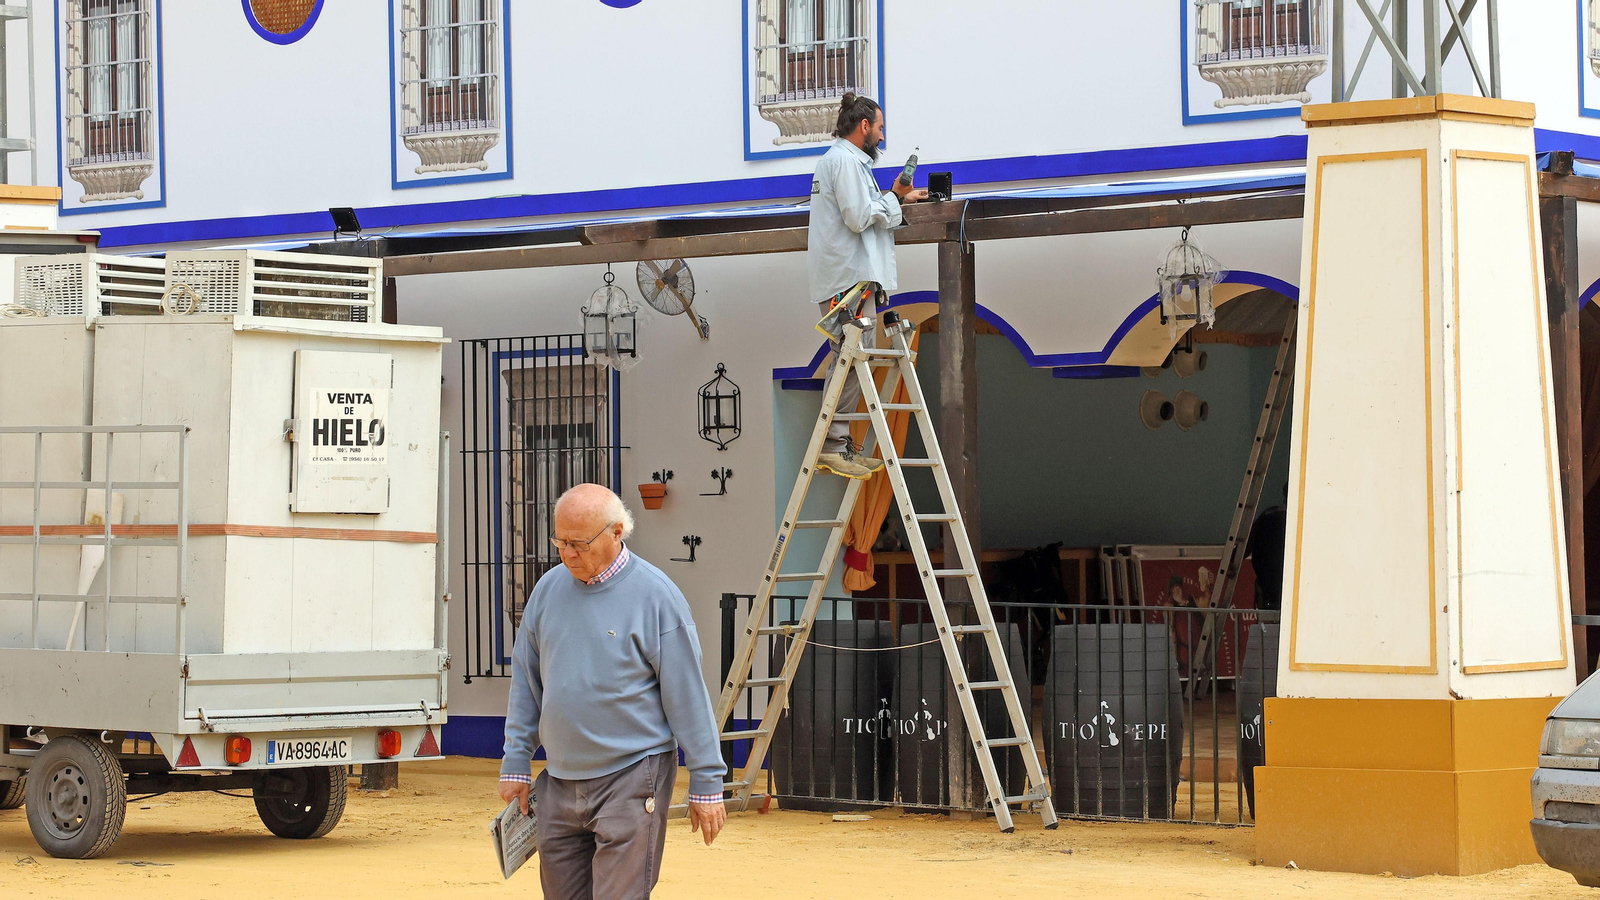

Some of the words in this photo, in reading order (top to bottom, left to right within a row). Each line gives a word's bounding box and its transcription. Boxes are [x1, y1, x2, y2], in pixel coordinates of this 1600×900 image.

[327, 393, 373, 404] VENTA
[344, 406, 354, 415] DE
[313, 419, 385, 446] HIELO
[1059, 721, 1095, 740] TIO
